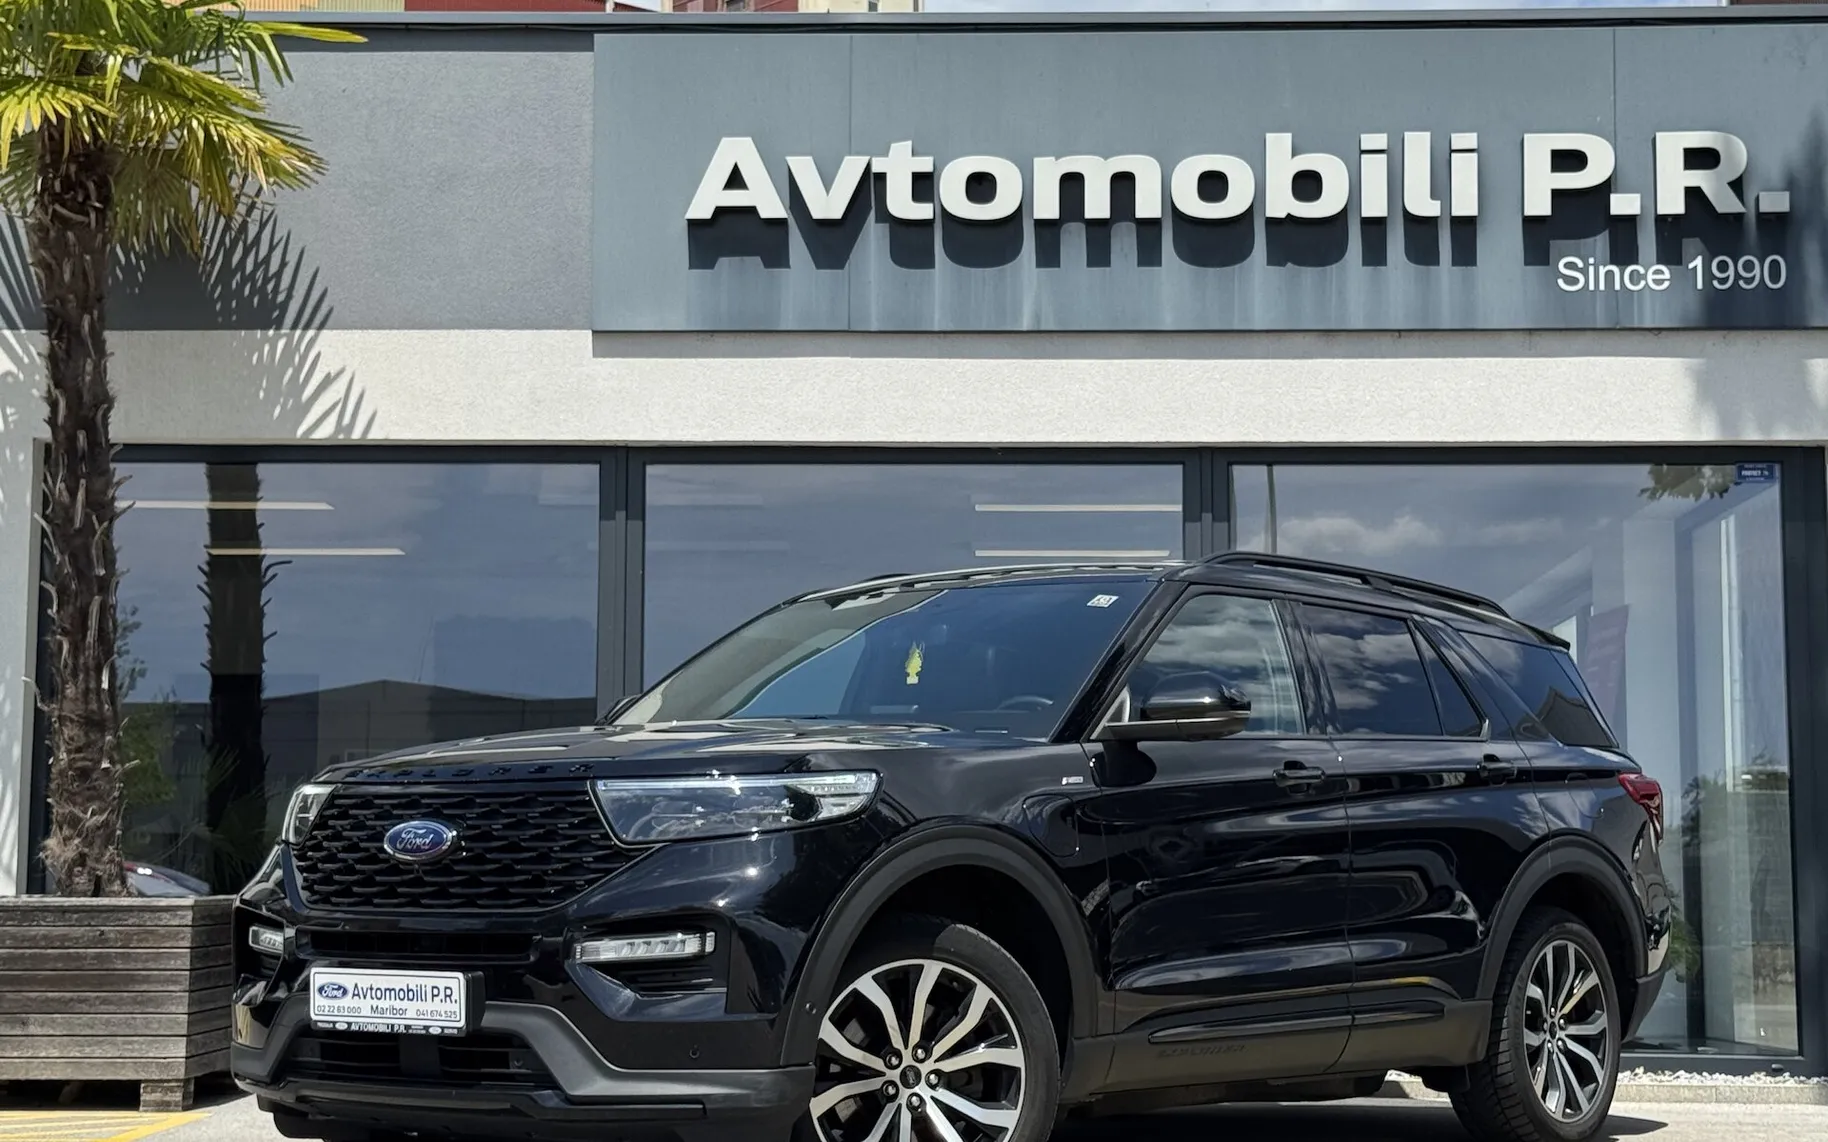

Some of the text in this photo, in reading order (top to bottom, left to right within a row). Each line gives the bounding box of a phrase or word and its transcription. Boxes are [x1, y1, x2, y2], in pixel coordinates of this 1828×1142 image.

[685, 131, 1790, 220] Avtomobili P.R.
[1557, 254, 1787, 291] Since 1990
[396, 827, 435, 850] Ford
[351, 982, 428, 1003] Avtomobili
[431, 985, 458, 1004] P.R.
[370, 1004, 408, 1017] Maribor
